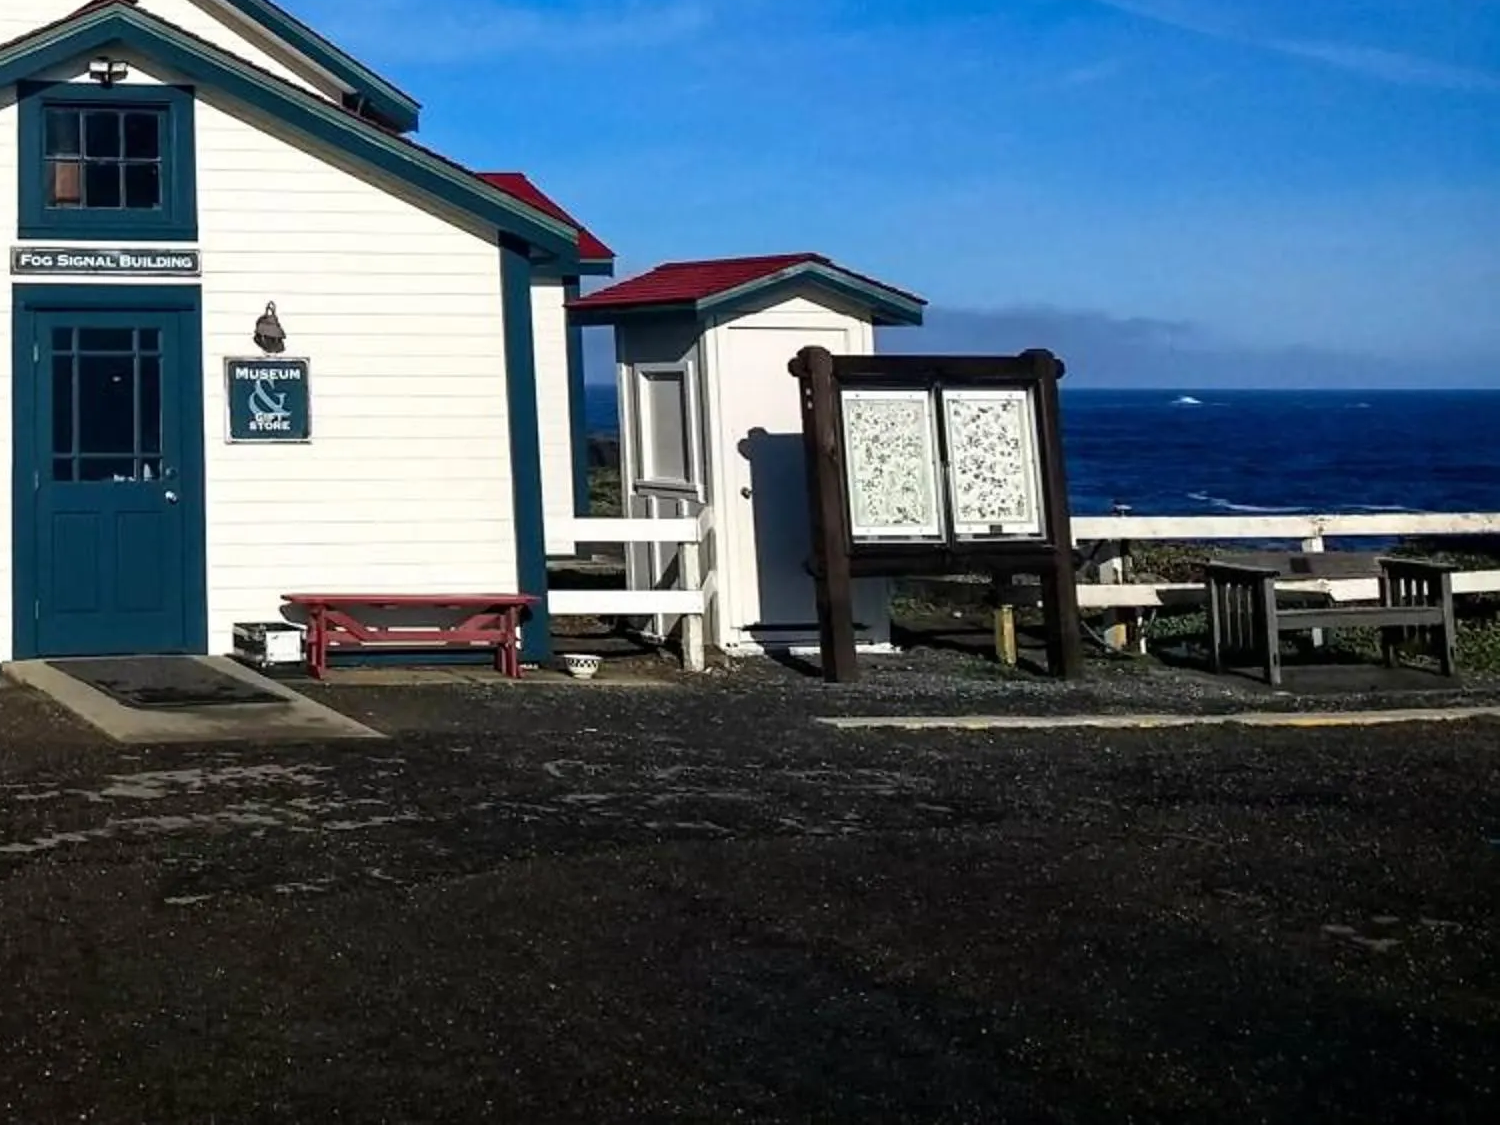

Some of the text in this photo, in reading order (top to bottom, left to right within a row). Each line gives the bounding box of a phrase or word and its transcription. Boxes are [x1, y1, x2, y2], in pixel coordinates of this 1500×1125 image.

[20, 253, 193, 269] FOG SIGNAL BUILDING
[235, 367, 301, 380] MUSEUM
